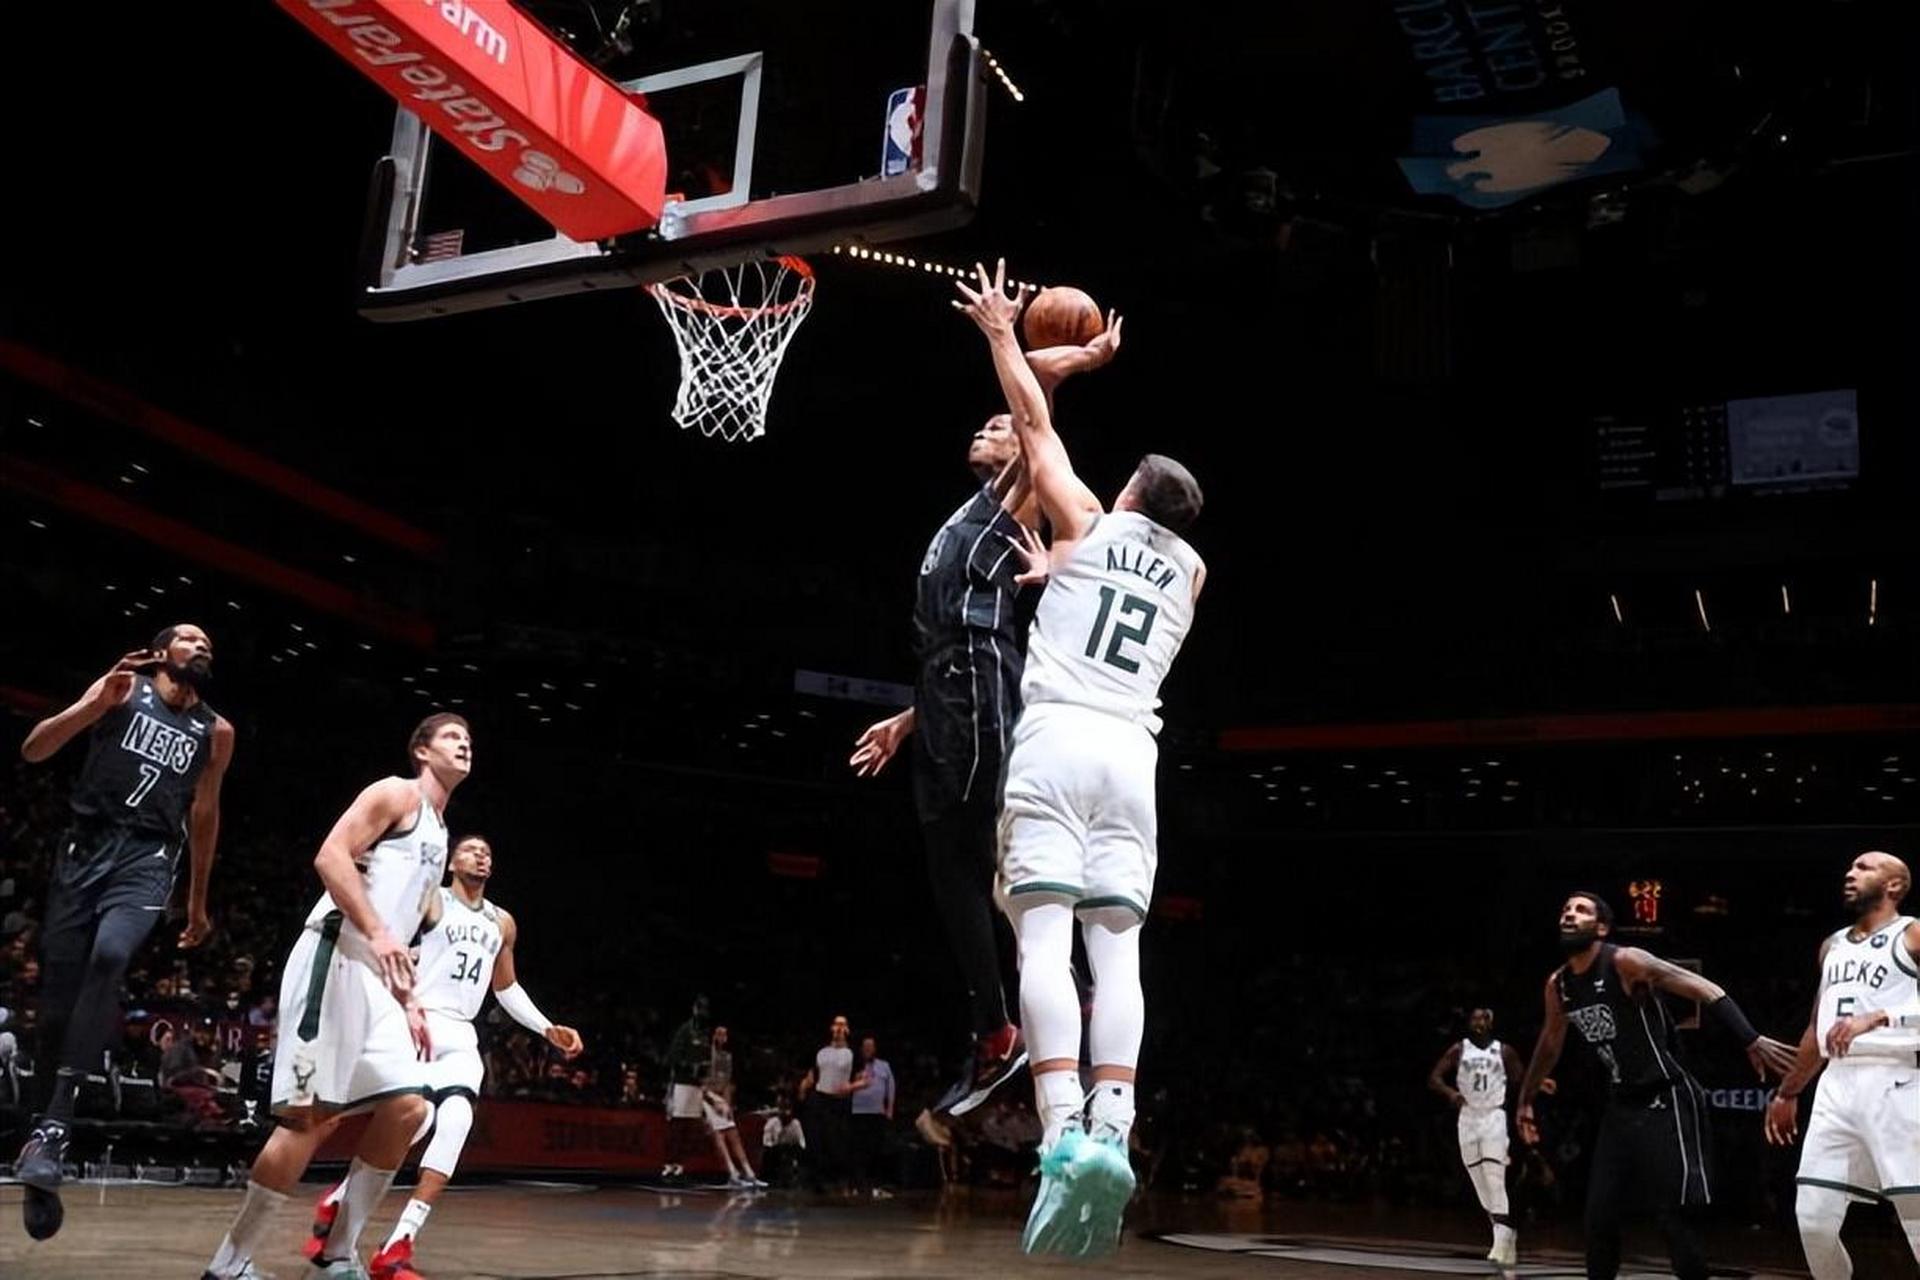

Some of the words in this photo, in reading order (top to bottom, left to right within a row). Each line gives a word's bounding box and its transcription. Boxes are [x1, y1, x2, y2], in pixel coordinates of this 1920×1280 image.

[424, 0, 506, 64] arm
[1106, 545, 1176, 590] ALLEN
[1084, 585, 1158, 674] 12
[121, 711, 198, 774] NETS
[125, 763, 161, 807] 7
[451, 951, 483, 985] 34
[1827, 959, 1888, 989] UCKS
[1473, 1072, 1488, 1092] 21
[1705, 1087, 1775, 1111] GEEK
